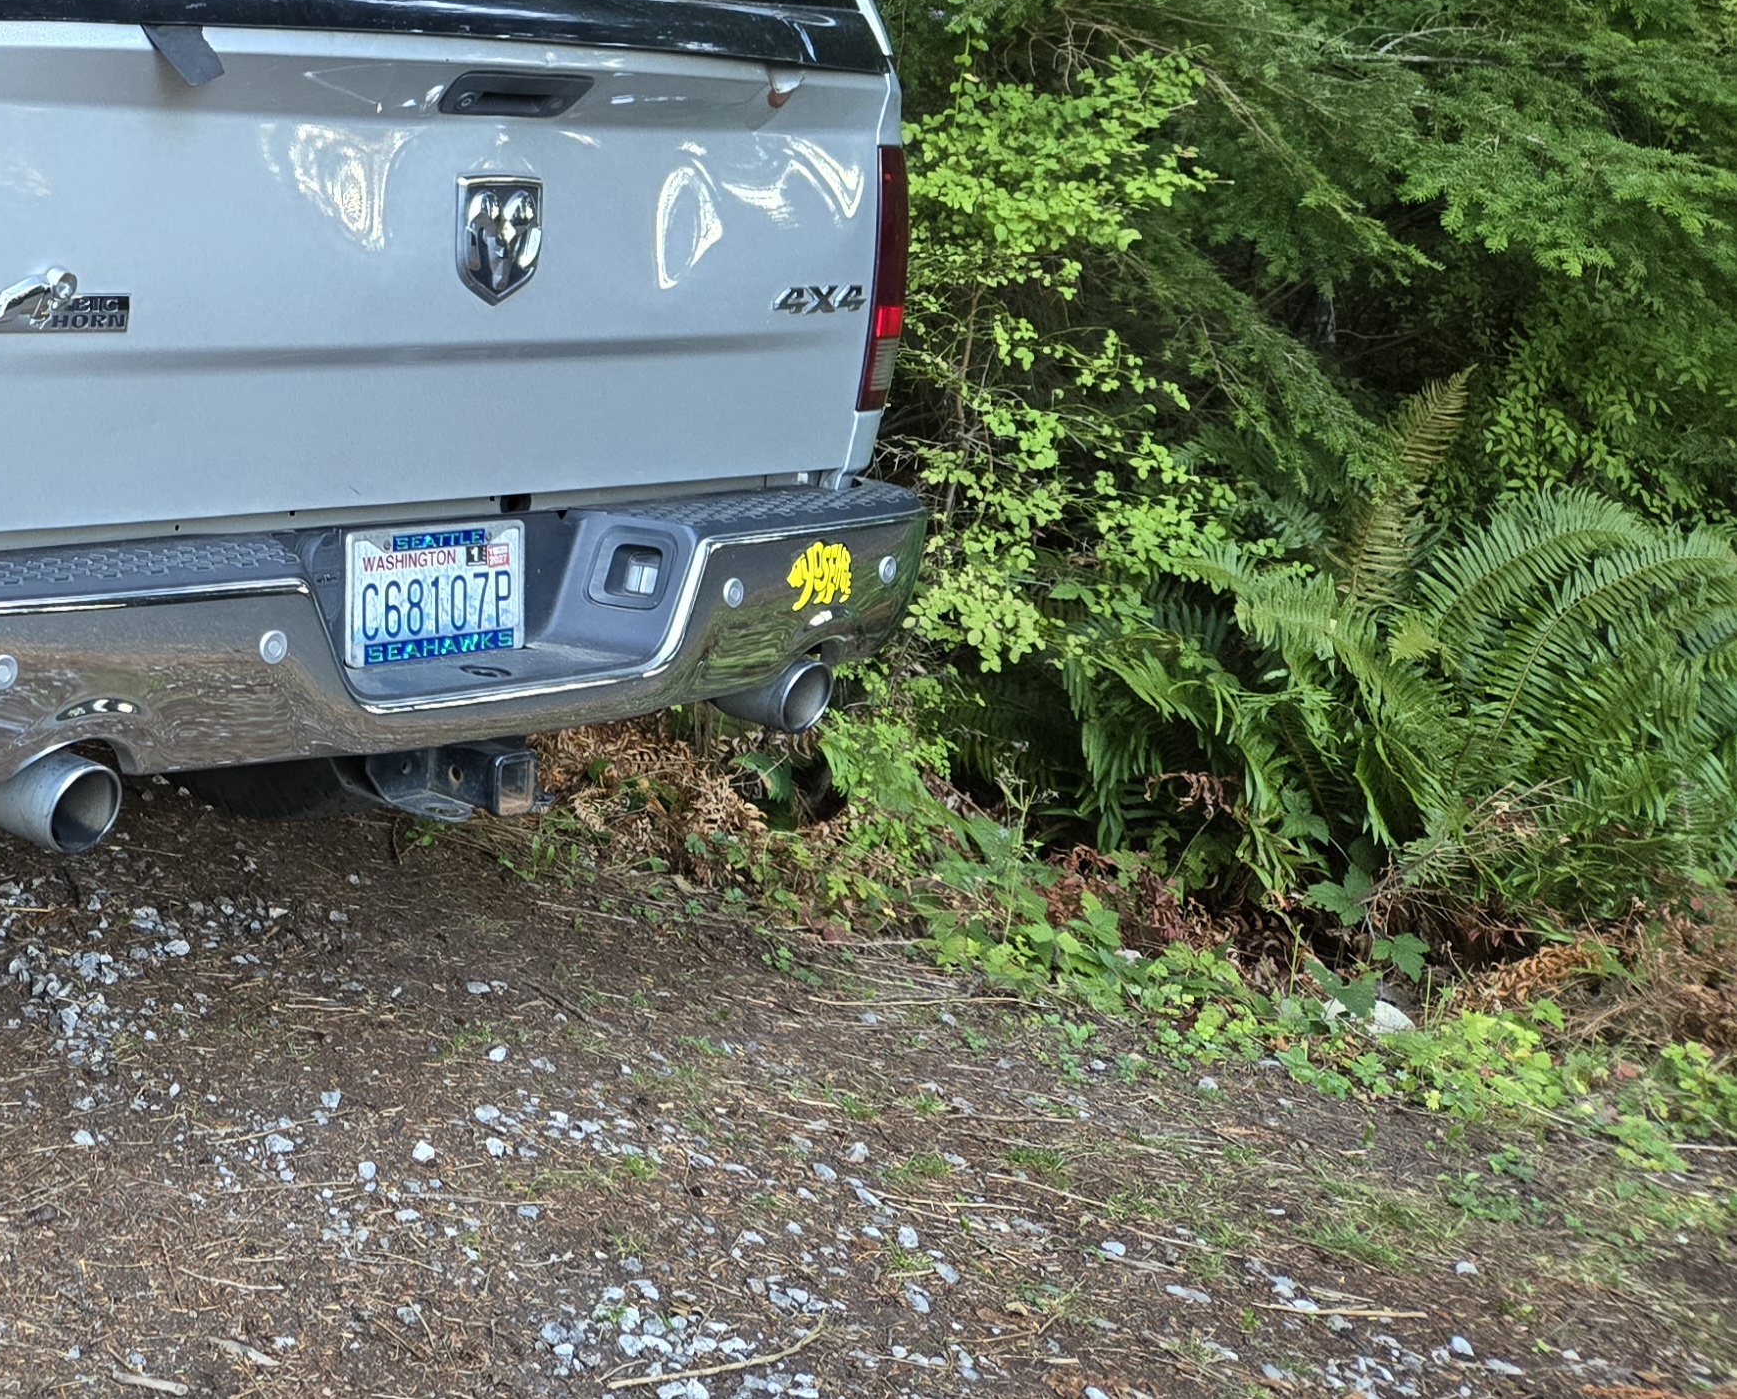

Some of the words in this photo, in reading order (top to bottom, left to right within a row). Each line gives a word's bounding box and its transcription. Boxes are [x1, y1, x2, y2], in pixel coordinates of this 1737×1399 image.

[73, 295, 121, 313] BIG
[772, 284, 867, 315] 4X4
[50, 313, 127, 329] HORN
[395, 529, 485, 550] SEATTLE
[363, 549, 457, 573] WASHINGTON
[362, 570, 512, 642] C68107P
[366, 630, 513, 664] SEAHAWKS
